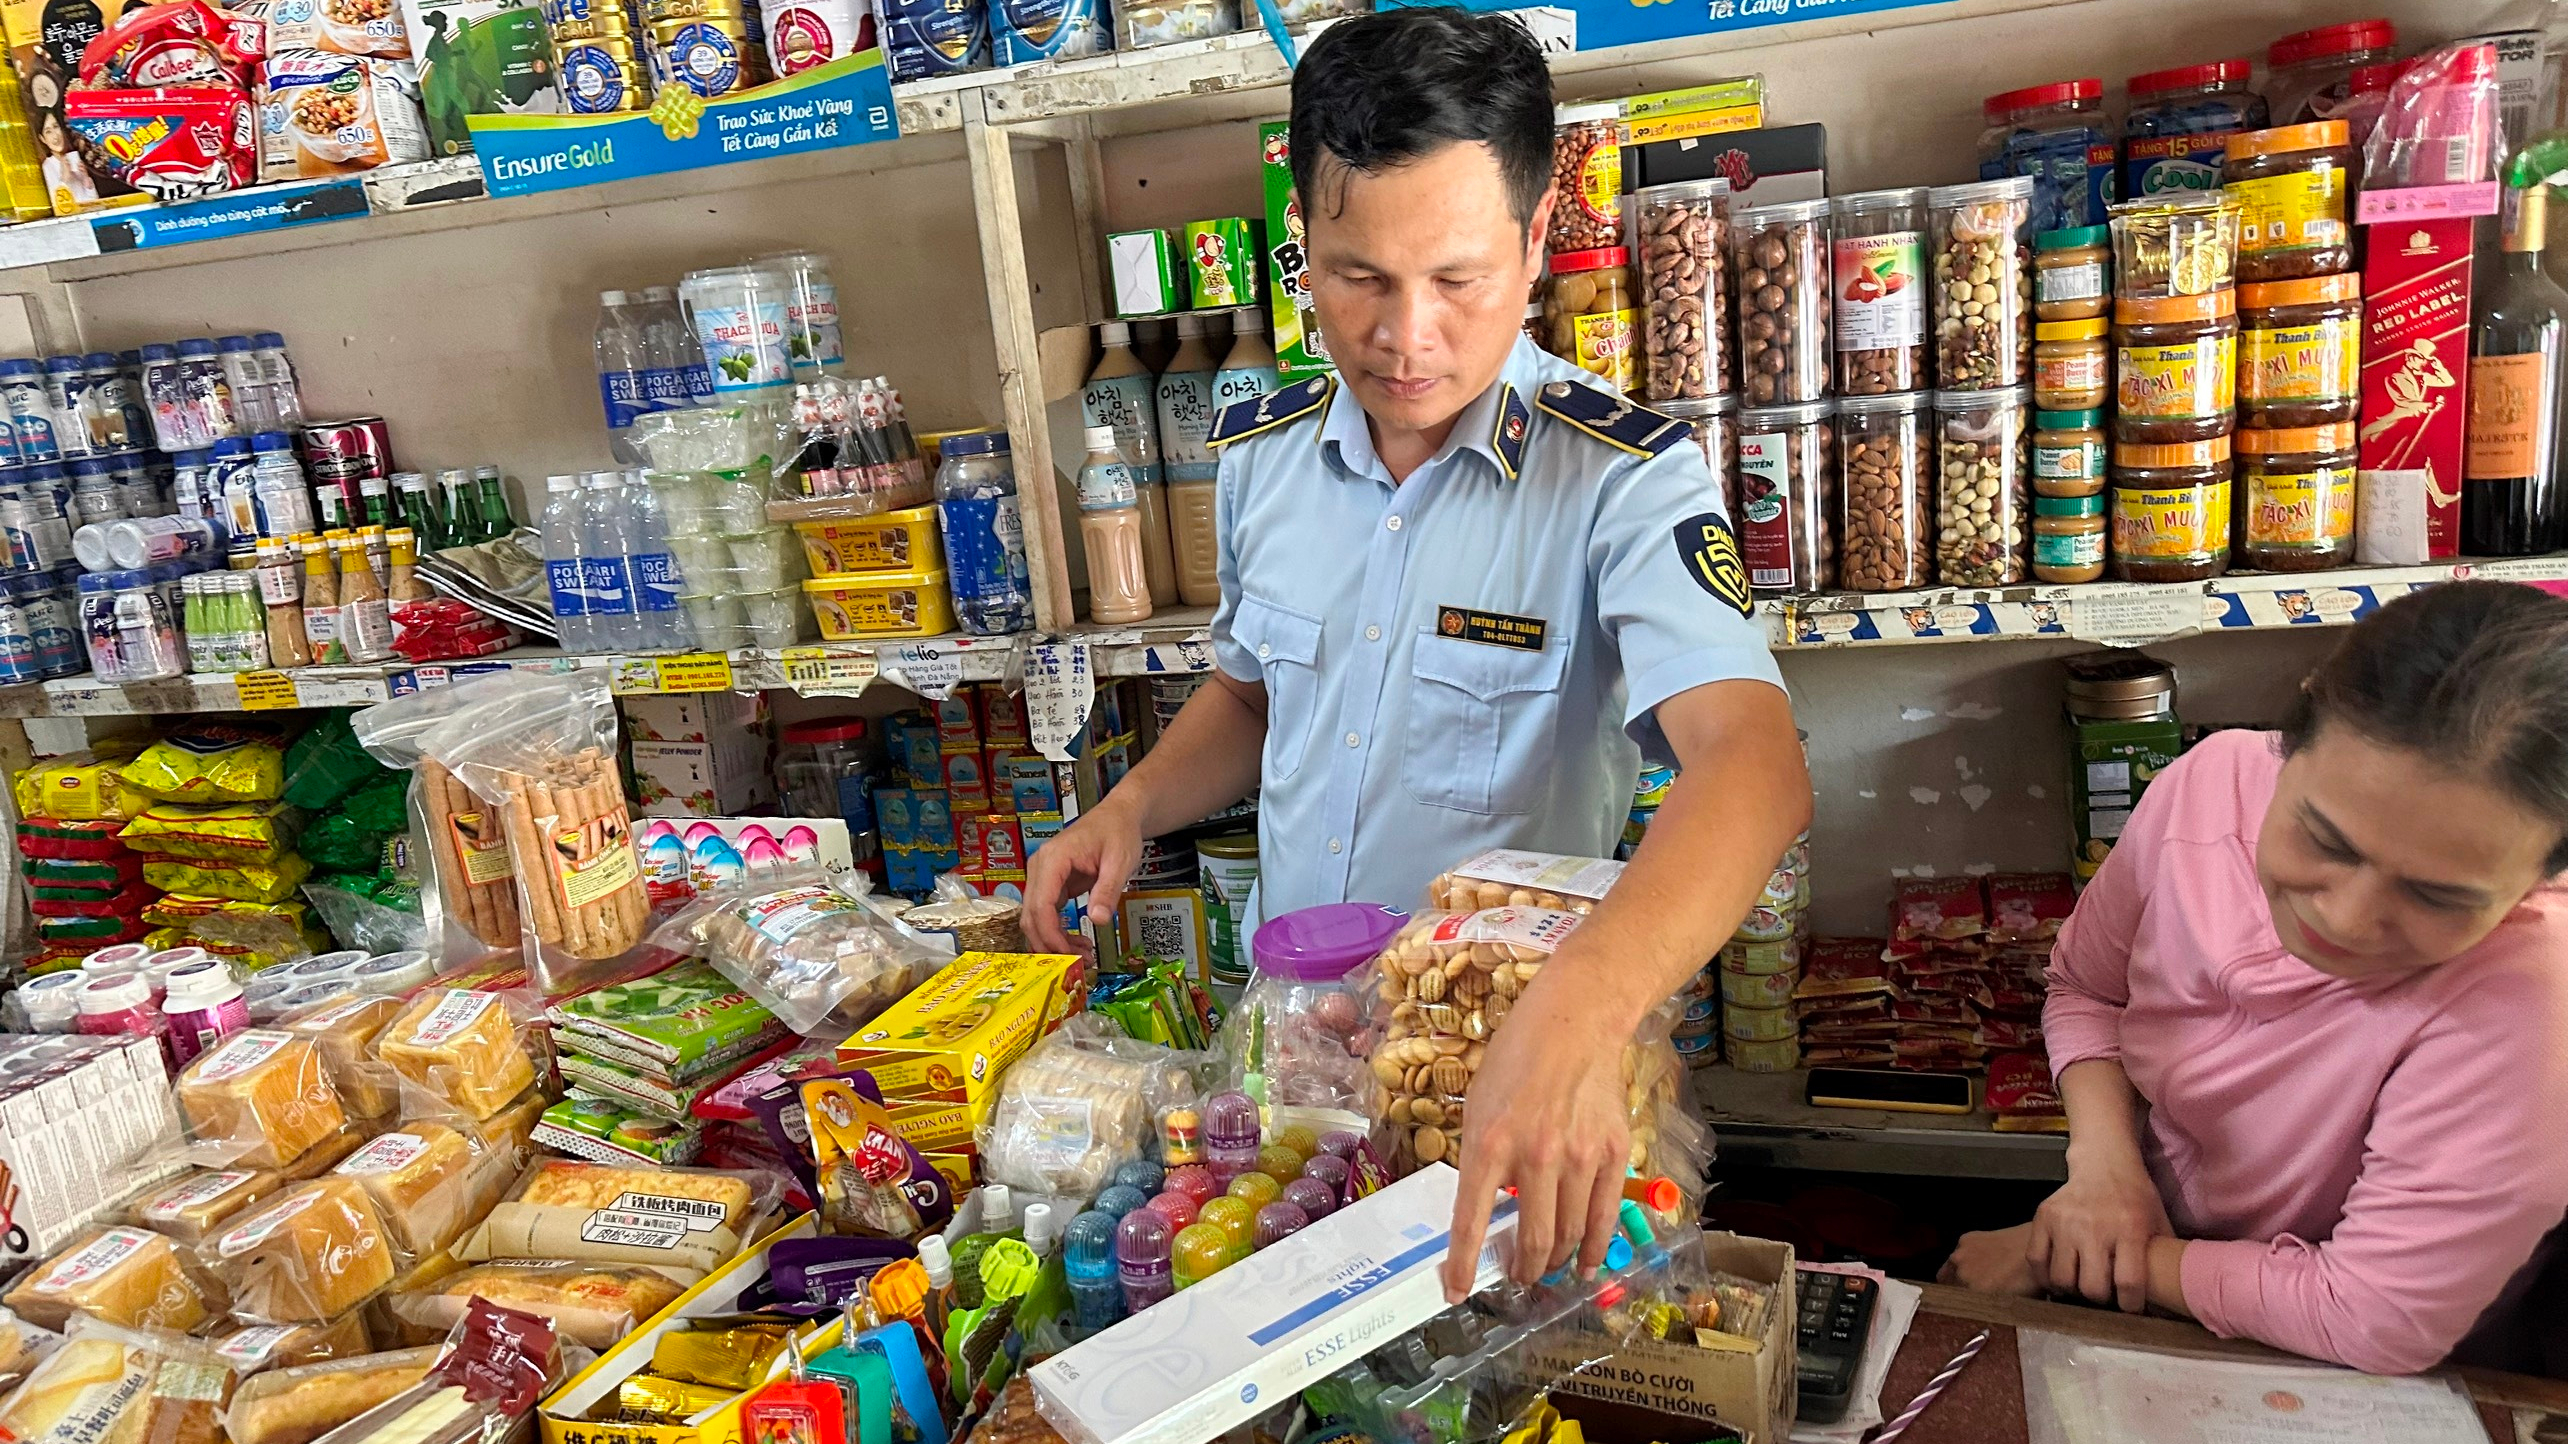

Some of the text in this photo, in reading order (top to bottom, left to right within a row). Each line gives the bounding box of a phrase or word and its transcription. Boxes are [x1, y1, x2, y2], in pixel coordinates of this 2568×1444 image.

[366, 21, 403, 37] 650g
[716, 113, 748, 132] Trao
[749, 106, 777, 127] Sức
[815, 98, 854, 121] Vàng
[336, 127, 374, 144] 650g
[720, 117, 839, 153] Tết Càng Gắn Kết
[2166, 137, 2189, 158] 15
[2375, 294, 2419, 318] JOHNNIE
[2371, 313, 2406, 334] RED
[1086, 384, 1122, 410] 아침
[1160, 377, 1197, 405] 아침
[900, 646, 939, 662] telio
[908, 660, 958, 676] Hàng Giá Tốt
[1071, 688, 1084, 699] 30
[675, 746, 703, 757] POWDER
[1012, 766, 1049, 779] Sanest
[631, 1195, 722, 1216] 铁板烤肉面包
[1326, 1256, 1375, 1285] Lights
[1336, 1264, 1394, 1299] ESSE
[1304, 1309, 1396, 1368] ESSE Lights
[1620, 1367, 1645, 1385] BÒ
[1649, 1371, 1695, 1394] CƯỜI
[1579, 1381, 1649, 1407] TRUYỀN
[1651, 1393, 1717, 1418] THỐNG
